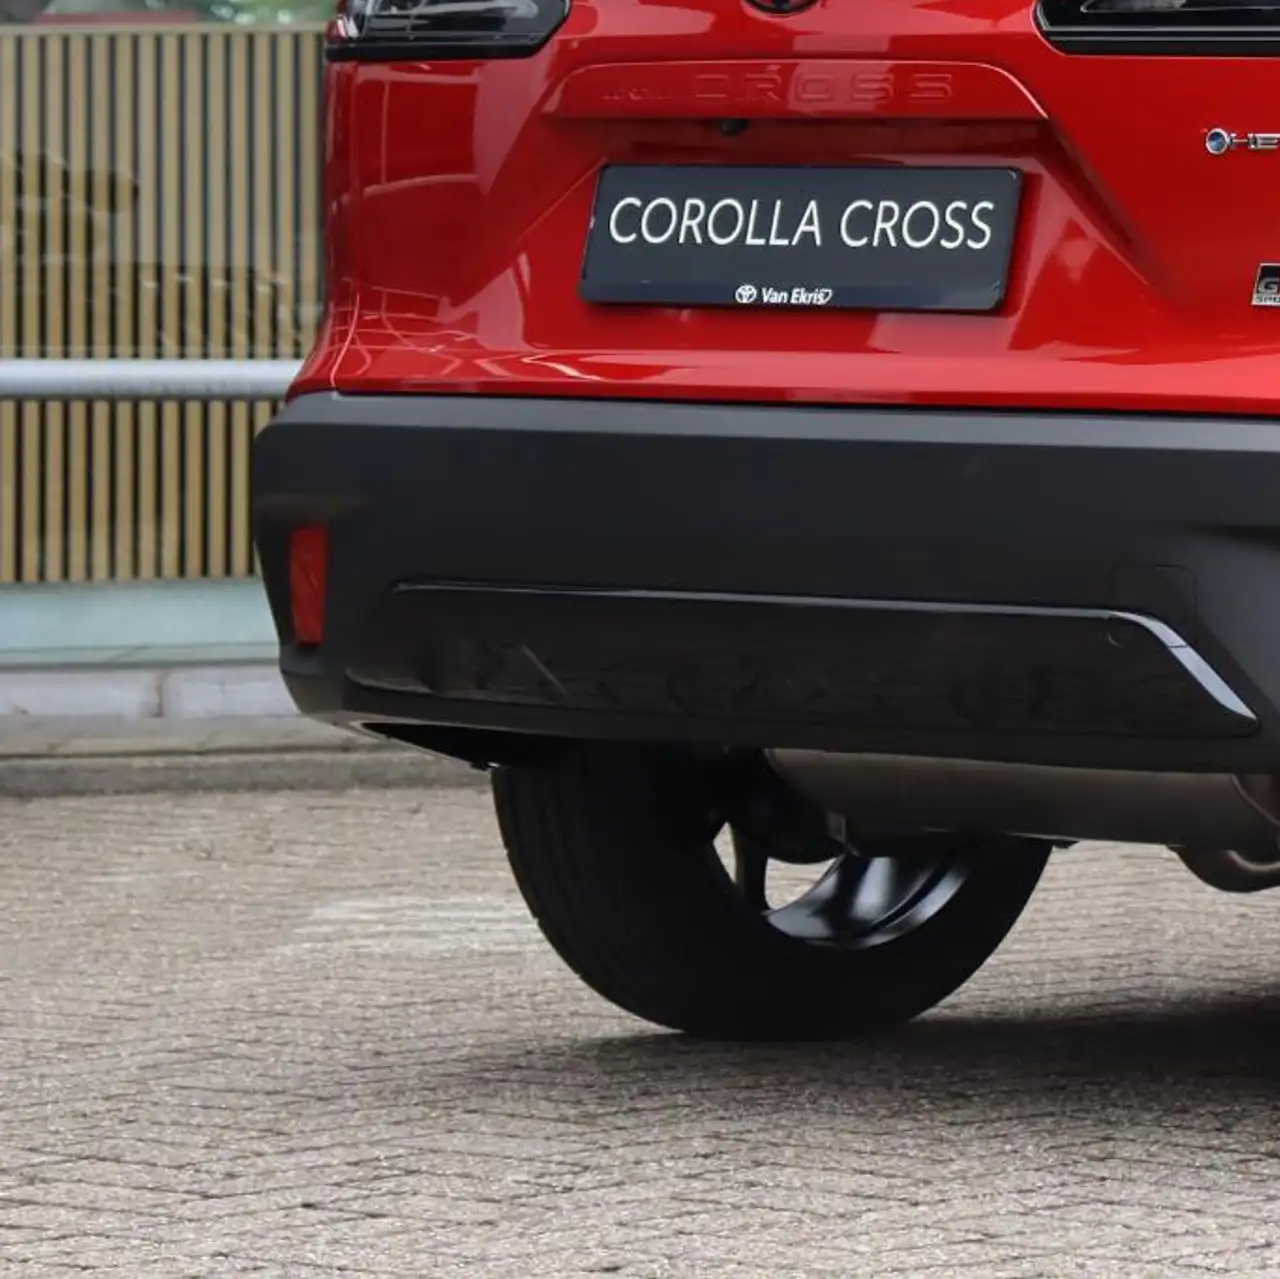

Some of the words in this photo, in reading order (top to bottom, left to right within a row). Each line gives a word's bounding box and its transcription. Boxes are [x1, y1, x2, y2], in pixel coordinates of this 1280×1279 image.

[609, 197, 822, 246] COROLLA
[840, 200, 993, 249] CROSS
[761, 287, 789, 303] Van
